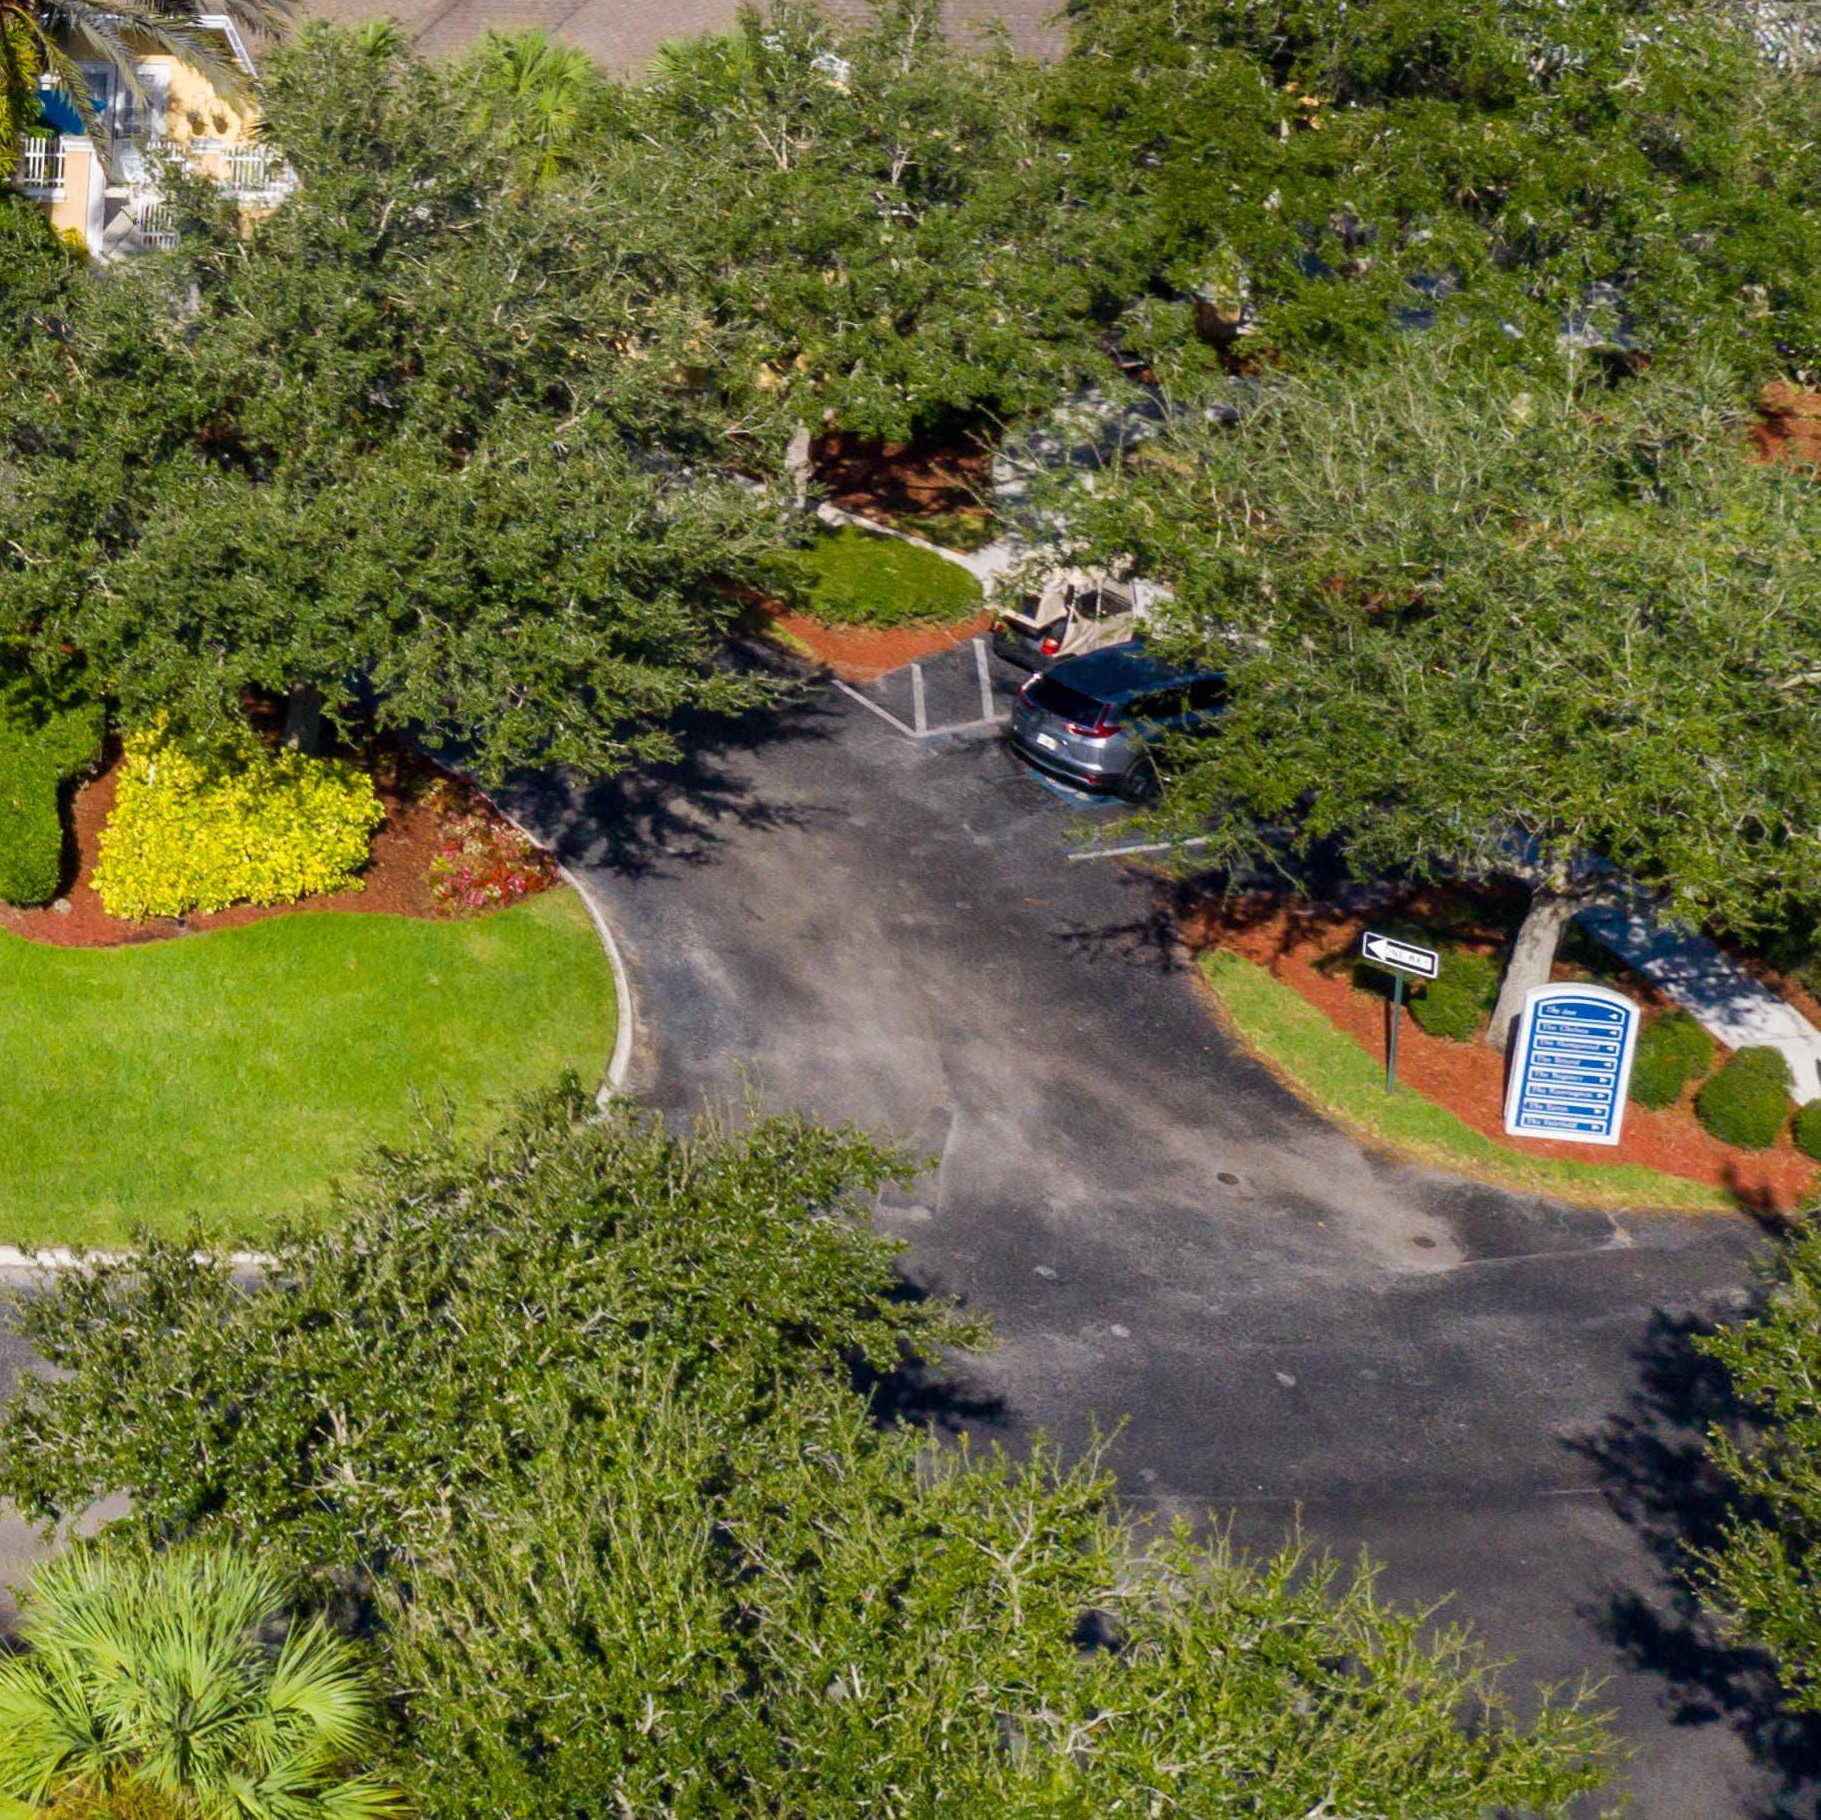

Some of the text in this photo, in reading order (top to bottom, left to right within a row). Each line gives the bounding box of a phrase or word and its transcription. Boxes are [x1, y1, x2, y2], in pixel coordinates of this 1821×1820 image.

[1384, 946, 1430, 967] ONE WAY
[1542, 1022, 1557, 1031] The
